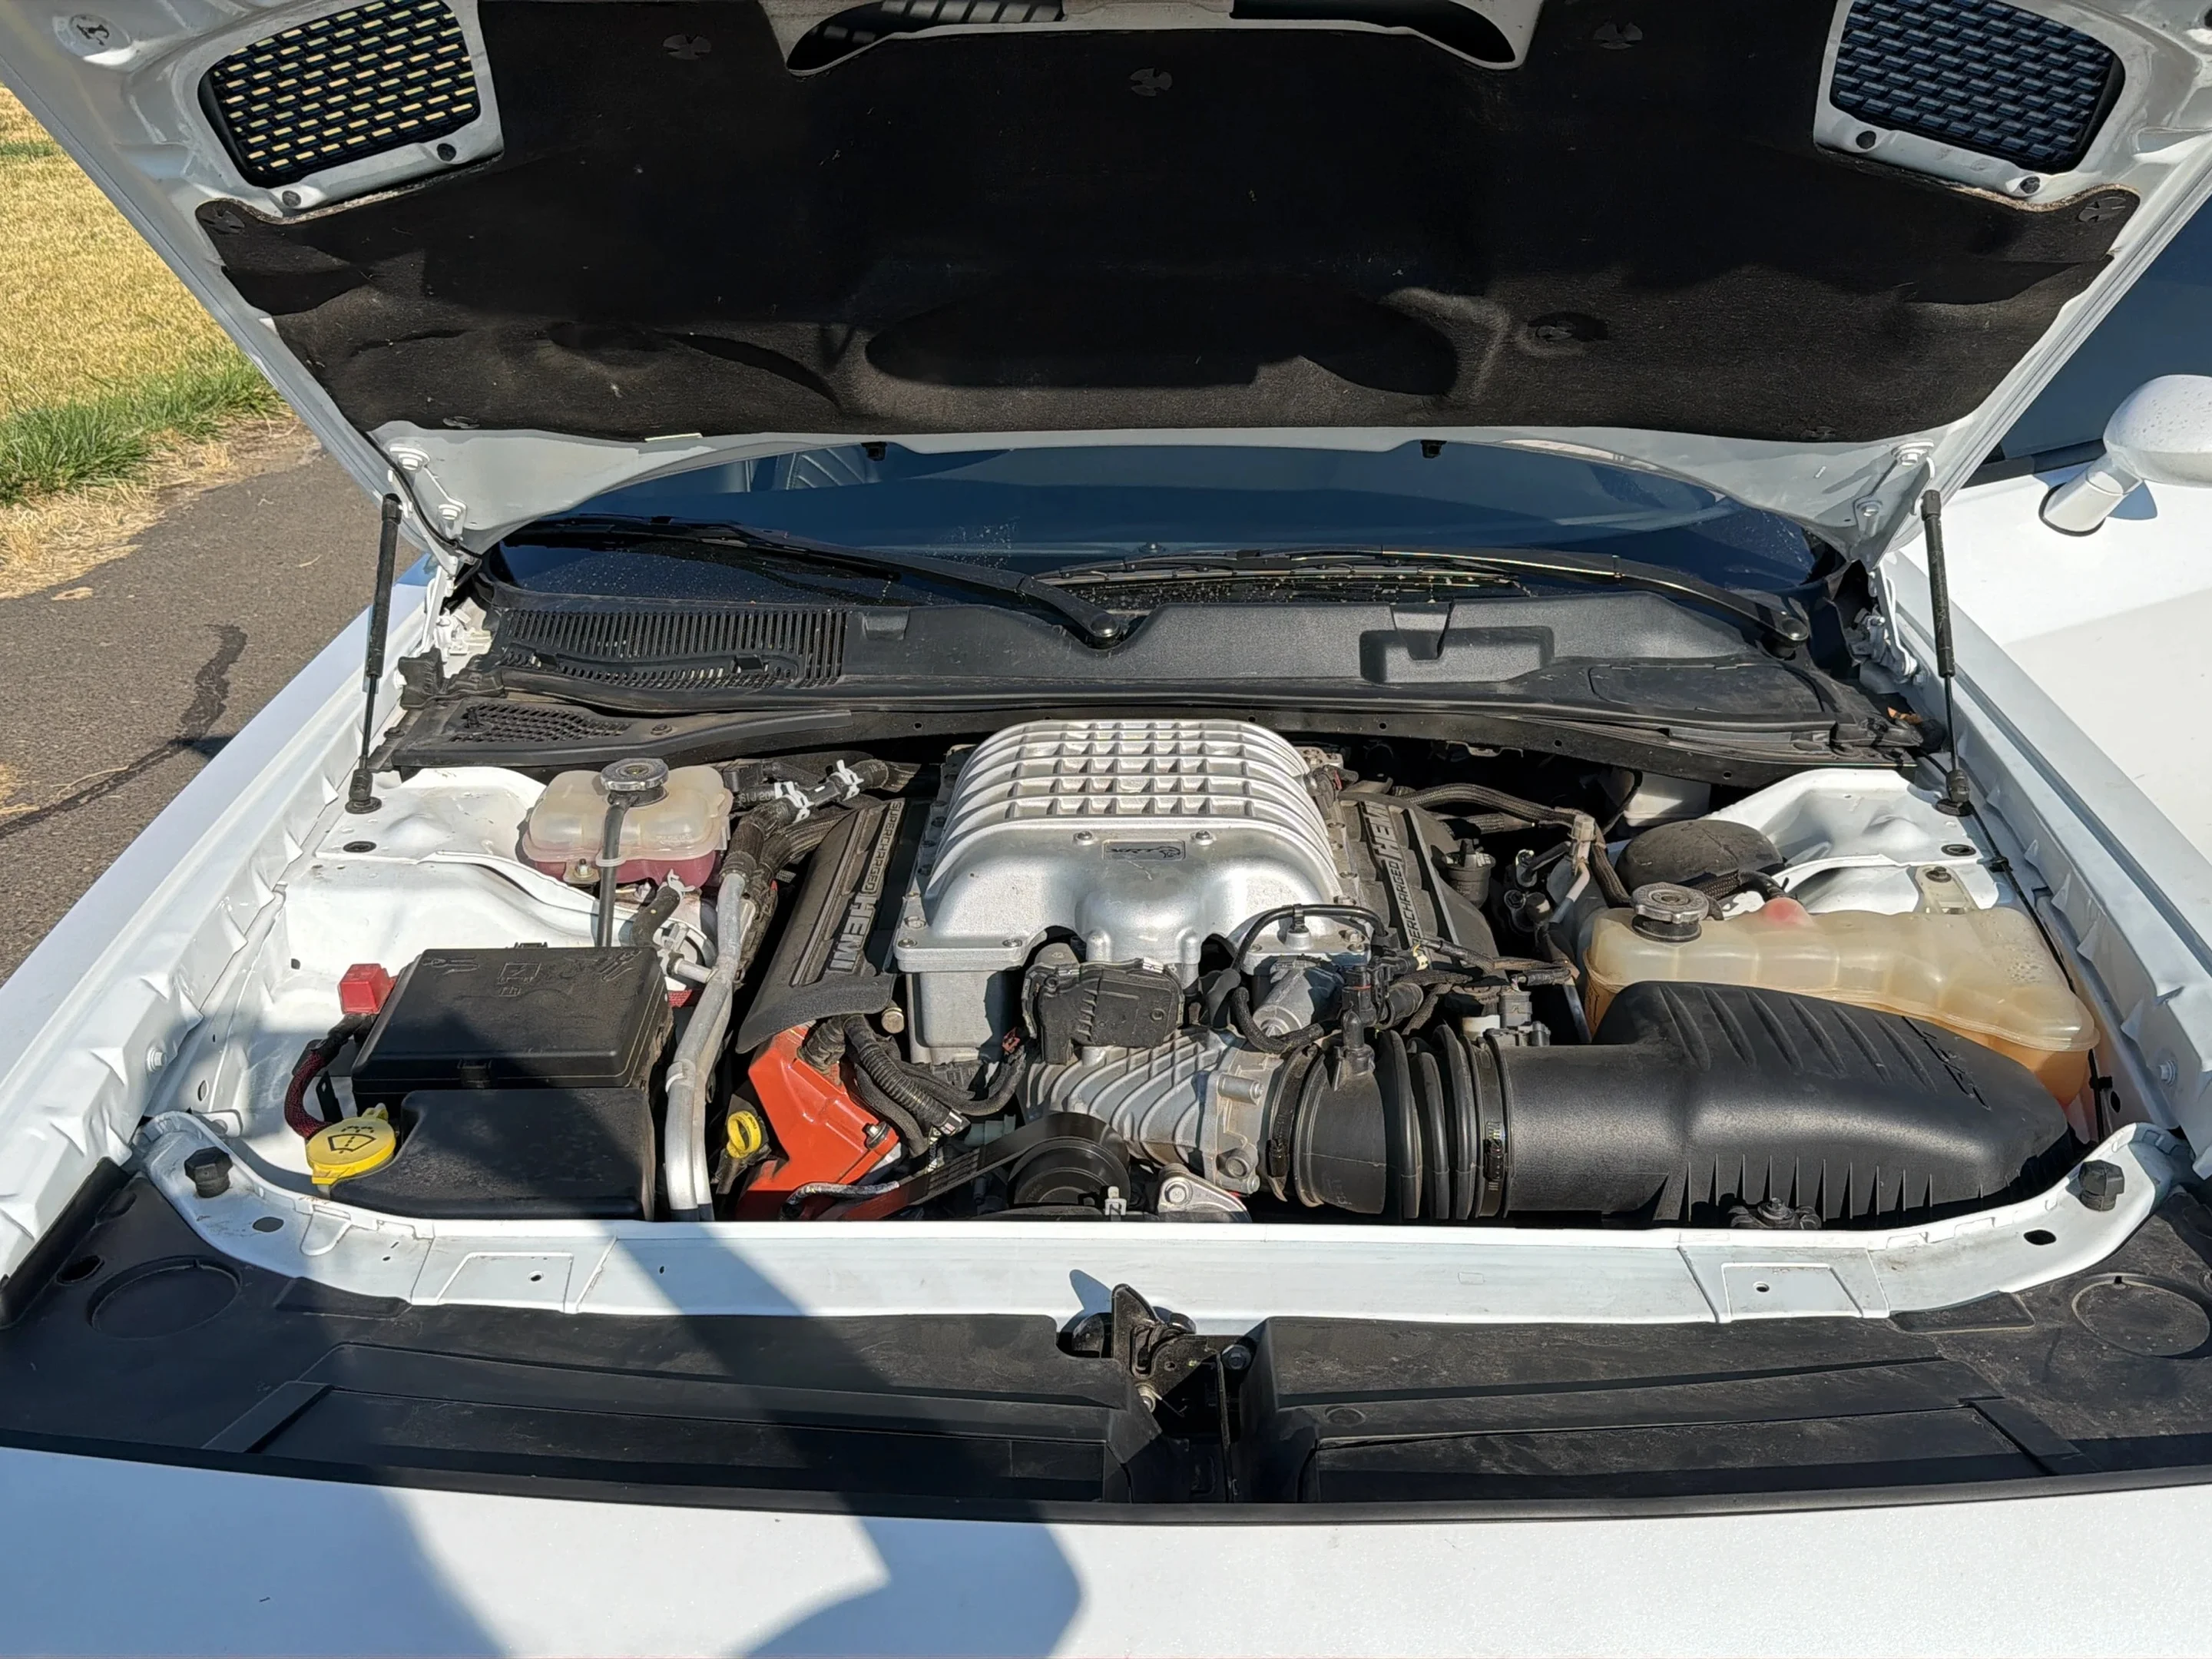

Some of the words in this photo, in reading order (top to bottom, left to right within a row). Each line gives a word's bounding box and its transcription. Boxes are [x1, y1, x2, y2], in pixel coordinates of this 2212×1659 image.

[863, 801, 902, 893] SUPERCHARGED
[1363, 801, 1403, 863] HEMI
[830, 892, 878, 972] HEMI
[1389, 859, 1421, 945] PERCHARGED
